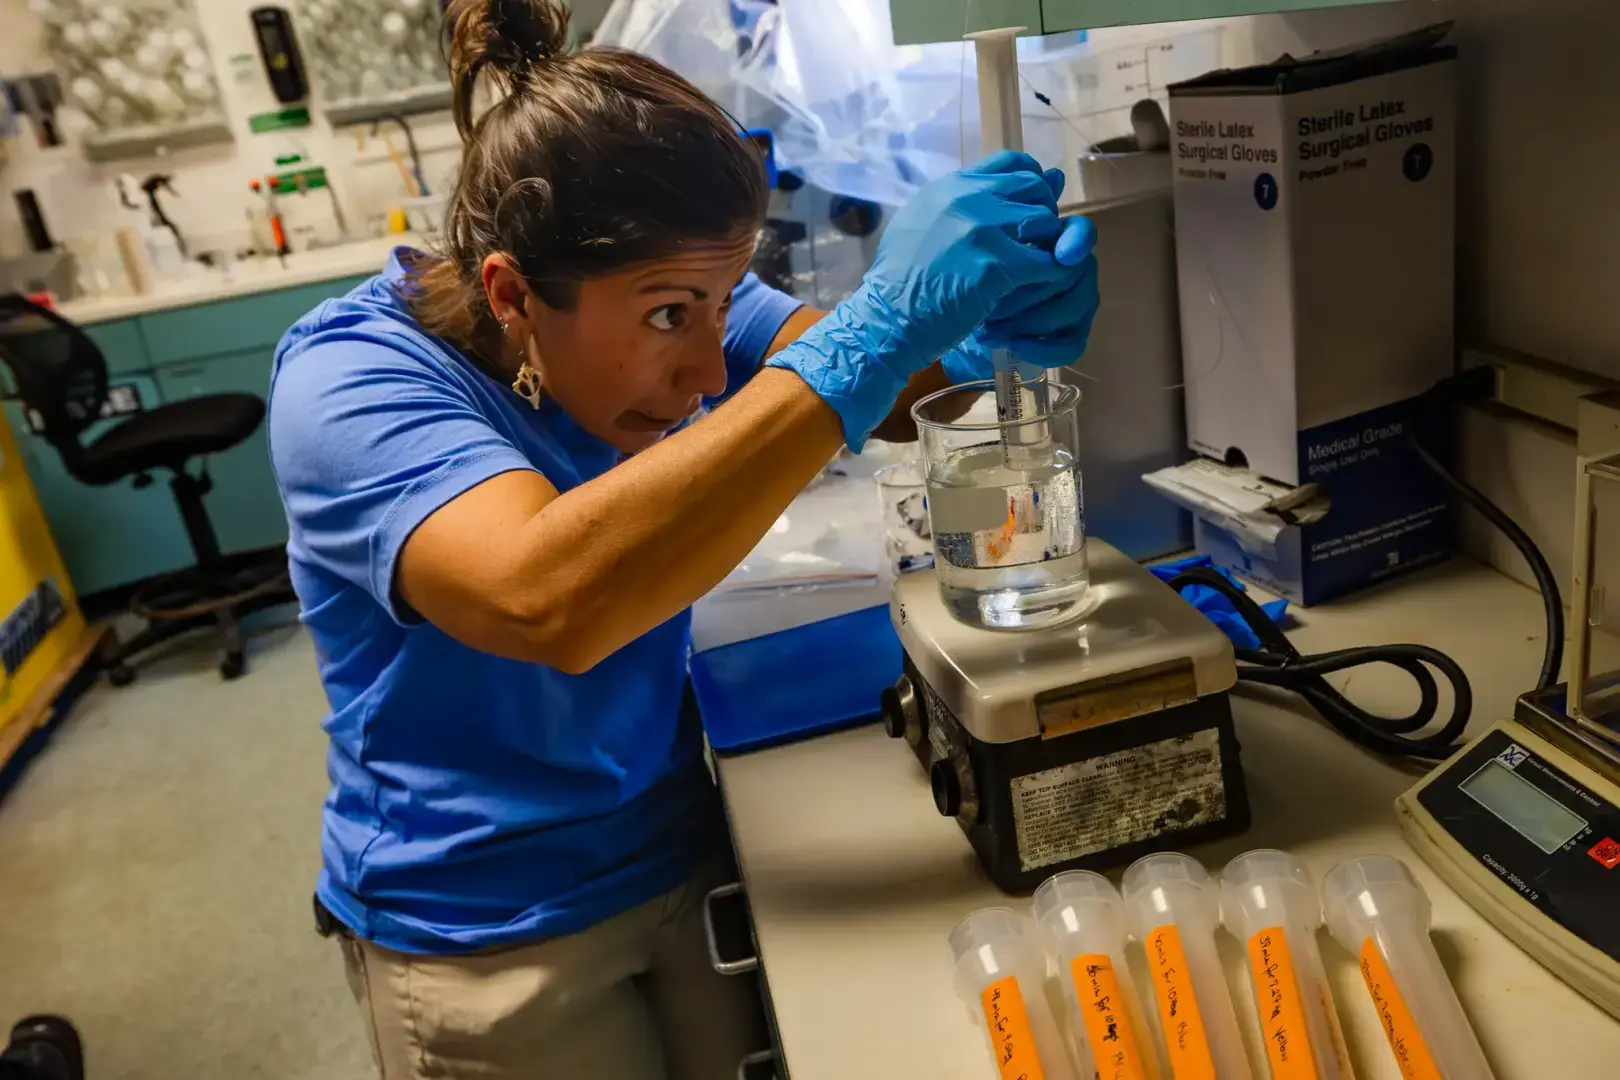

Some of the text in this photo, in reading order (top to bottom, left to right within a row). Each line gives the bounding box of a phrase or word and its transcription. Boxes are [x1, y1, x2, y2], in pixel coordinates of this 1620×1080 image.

[1297, 100, 1406, 136] Sterile Latex
[1176, 121, 1254, 138] Sterile Latex
[1298, 117, 1434, 161] Surgical Gloves
[1178, 142, 1278, 163] Surgical Gloves
[1413, 154, 1421, 170] 7
[1262, 184, 1269, 199] 7
[1308, 423, 1402, 459] Medical Grade
[1095, 755, 1137, 771] WARNING
[1021, 789, 1036, 797] KEEP
[1052, 778, 1080, 789] SURFACE
[1580, 791, 1601, 807] Control
[1023, 809, 1050, 820] REPLACE
[1482, 854, 1508, 875] Capacity:
[1508, 874, 1526, 891] 3000g
[1530, 891, 1539, 901] 1g
[1270, 1024, 1288, 1062] Yellow
